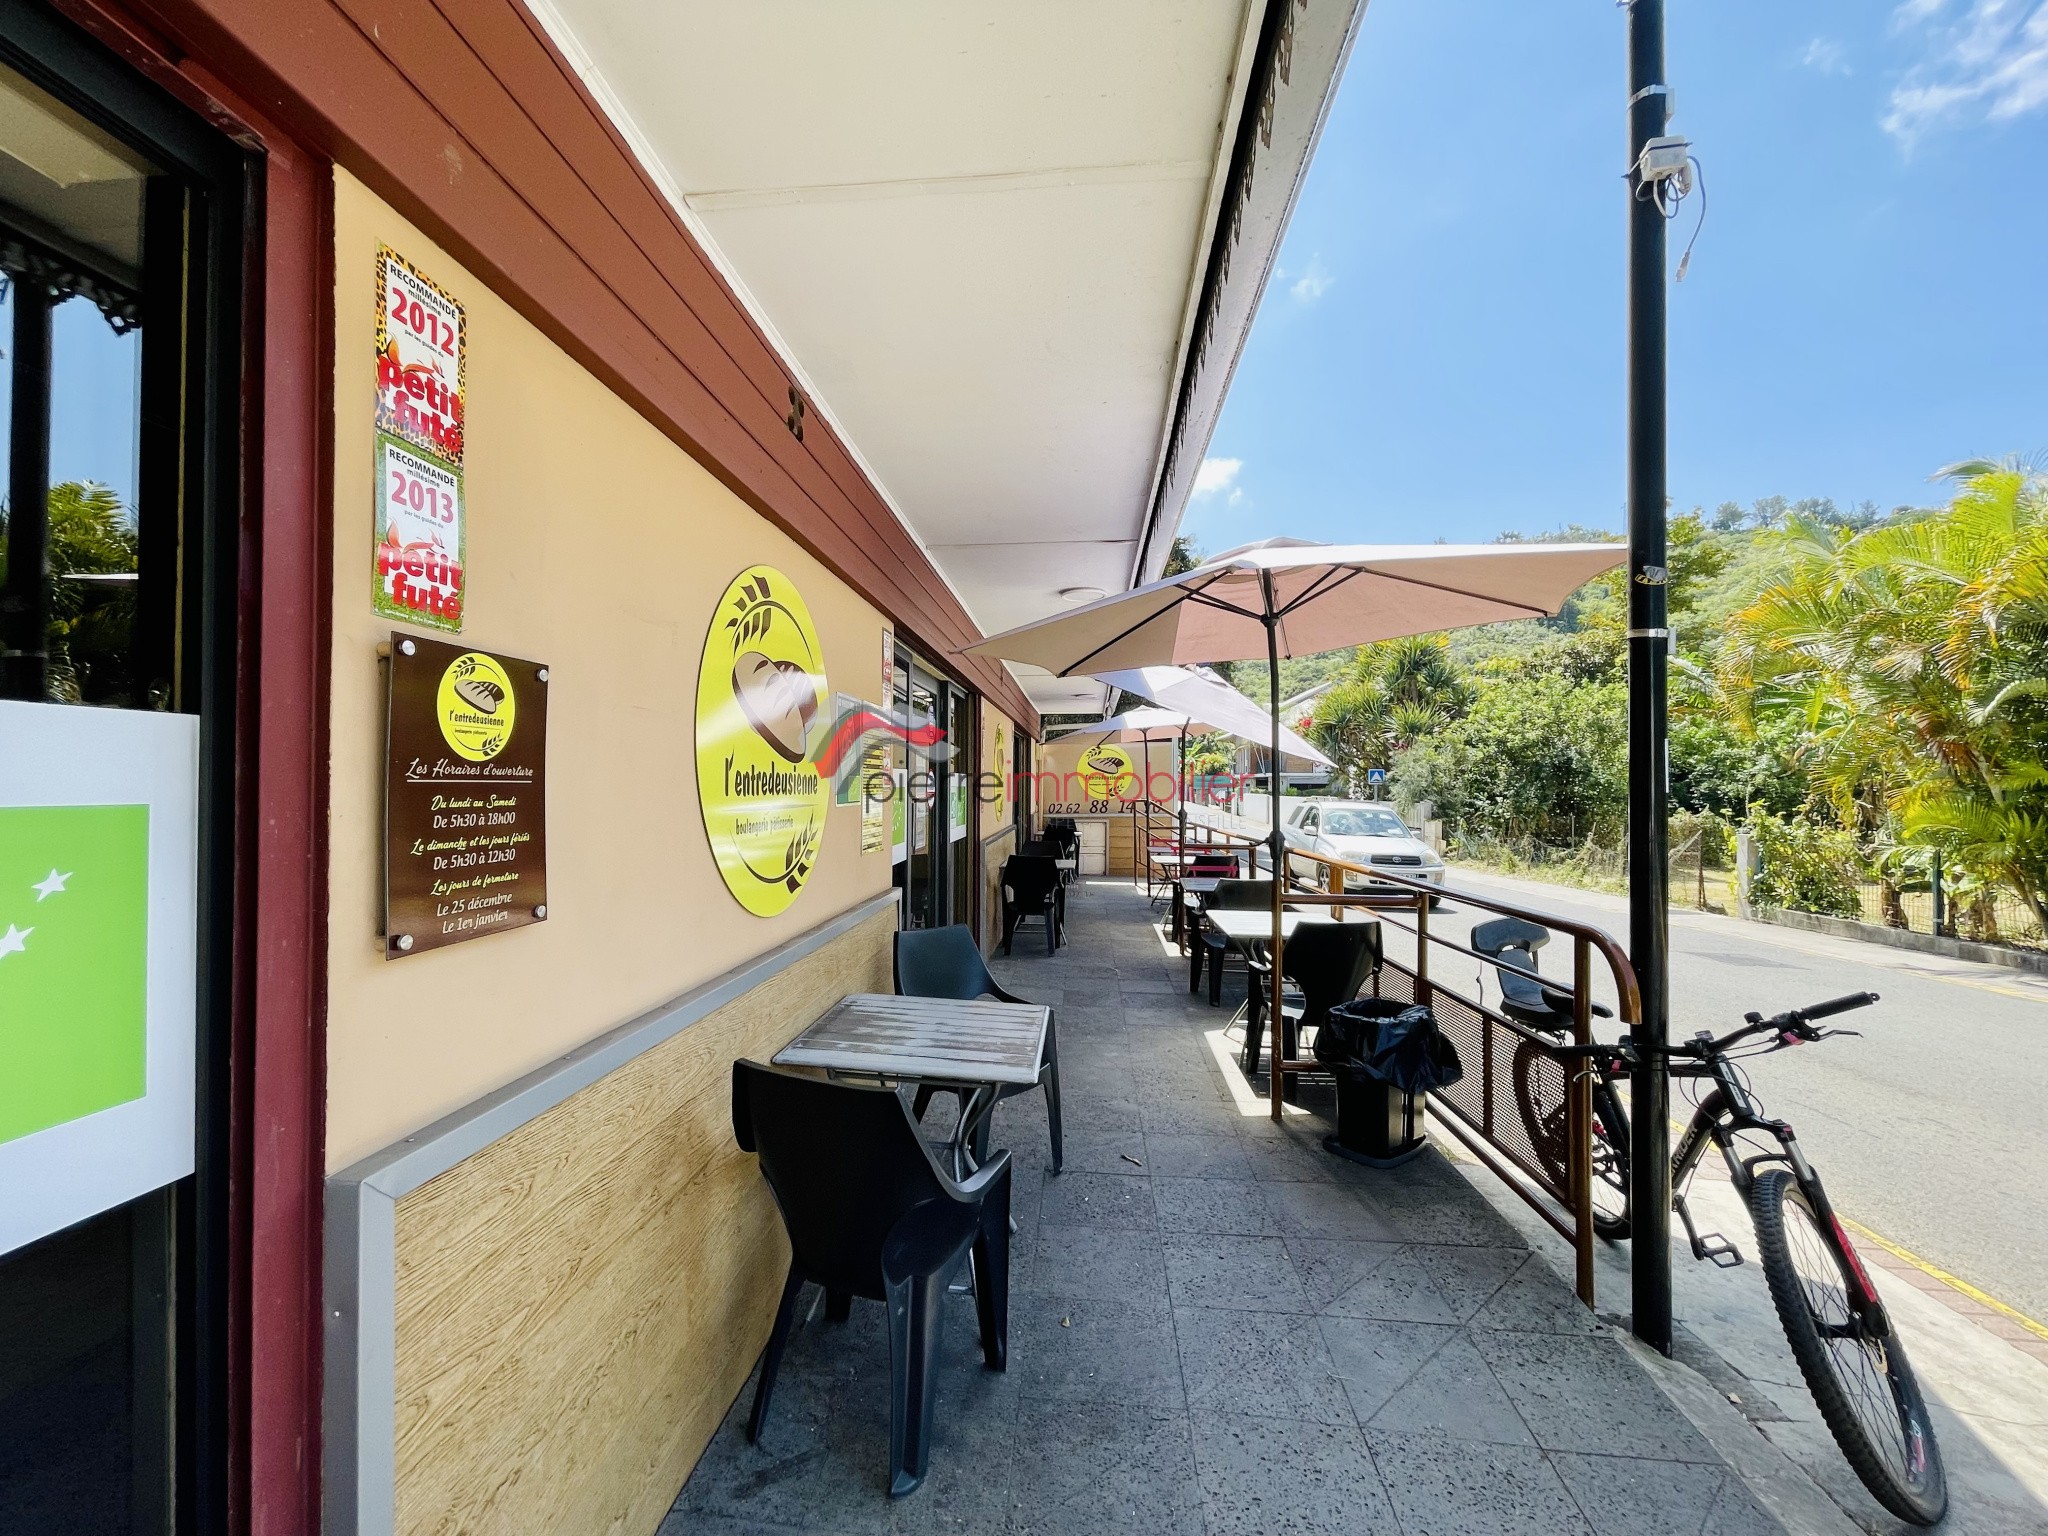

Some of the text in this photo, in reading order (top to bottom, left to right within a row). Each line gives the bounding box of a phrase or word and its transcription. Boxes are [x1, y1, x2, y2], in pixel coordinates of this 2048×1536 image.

[390, 263, 456, 320] RECOMMANDÉ
[392, 287, 454, 357] 2012
[377, 355, 463, 424] petit
[393, 391, 463, 453] futé
[389, 448, 455, 487] RECOMMANDÉ
[391, 471, 454, 524] 2013
[378, 542, 463, 590] petit
[392, 572, 461, 621] futé
[405, 758, 534, 779] Les Horaires d'ouverture
[724, 745, 818, 797] l'entredeusienne
[431, 794, 517, 810] Du lundi au Samedi
[1048, 803, 1063, 814] 02
[1066, 803, 1081, 814] 62
[1089, 799, 1109, 814] 88
[433, 812, 516, 829] De 5h30 à 18h00
[410, 838, 424, 855] Le
[427, 837, 467, 851] dimanche
[469, 837, 478, 847] et
[478, 835, 490, 846] les
[489, 835, 510, 849] jours
[433, 848, 516, 870] De 5h30 à 12h30
[431, 872, 519, 896] Les jours de fermeture
[437, 892, 512, 917] Le 25 décembre
[442, 909, 509, 934] Le 1er janvier
